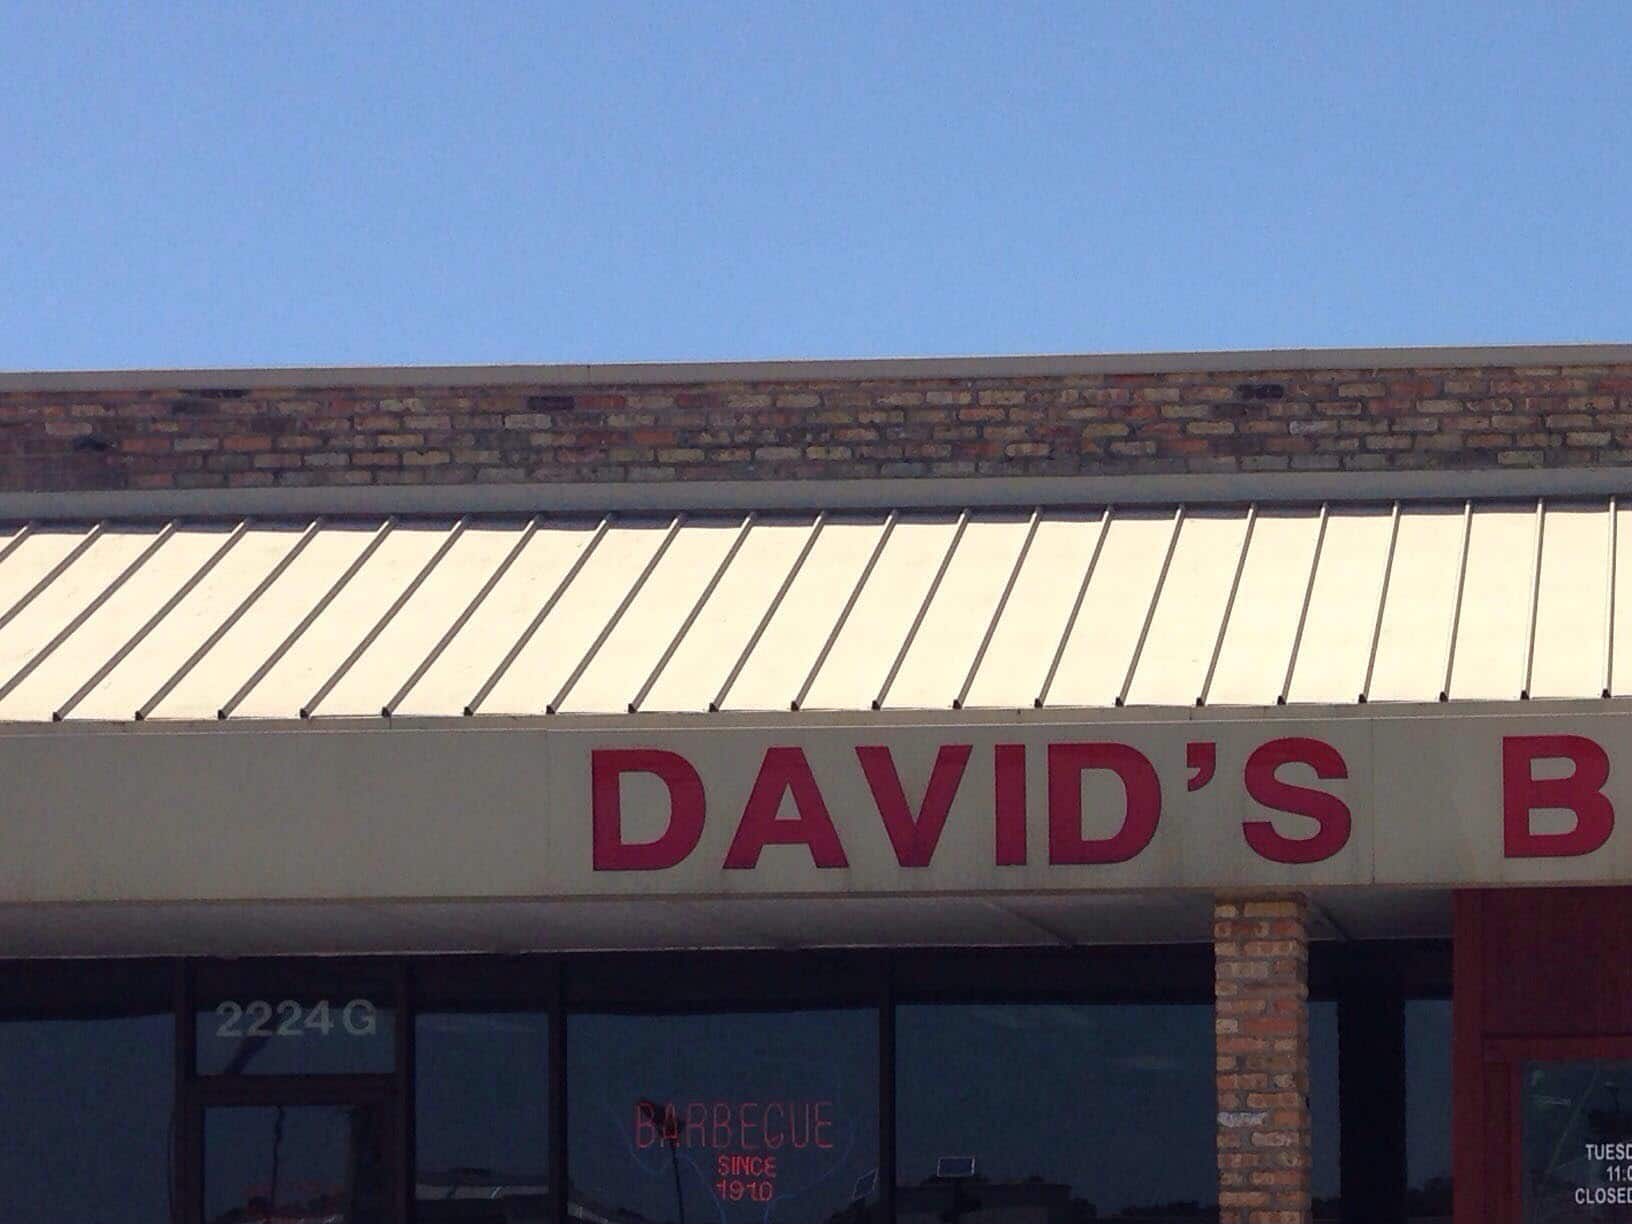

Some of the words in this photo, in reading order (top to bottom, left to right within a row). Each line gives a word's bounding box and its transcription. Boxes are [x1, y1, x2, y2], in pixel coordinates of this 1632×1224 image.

[592, 736, 1352, 871] DAVID'S
[634, 1100, 833, 1149] BARBECUE
[717, 1155, 777, 1177] SINCE
[715, 1180, 775, 1201] 1910
